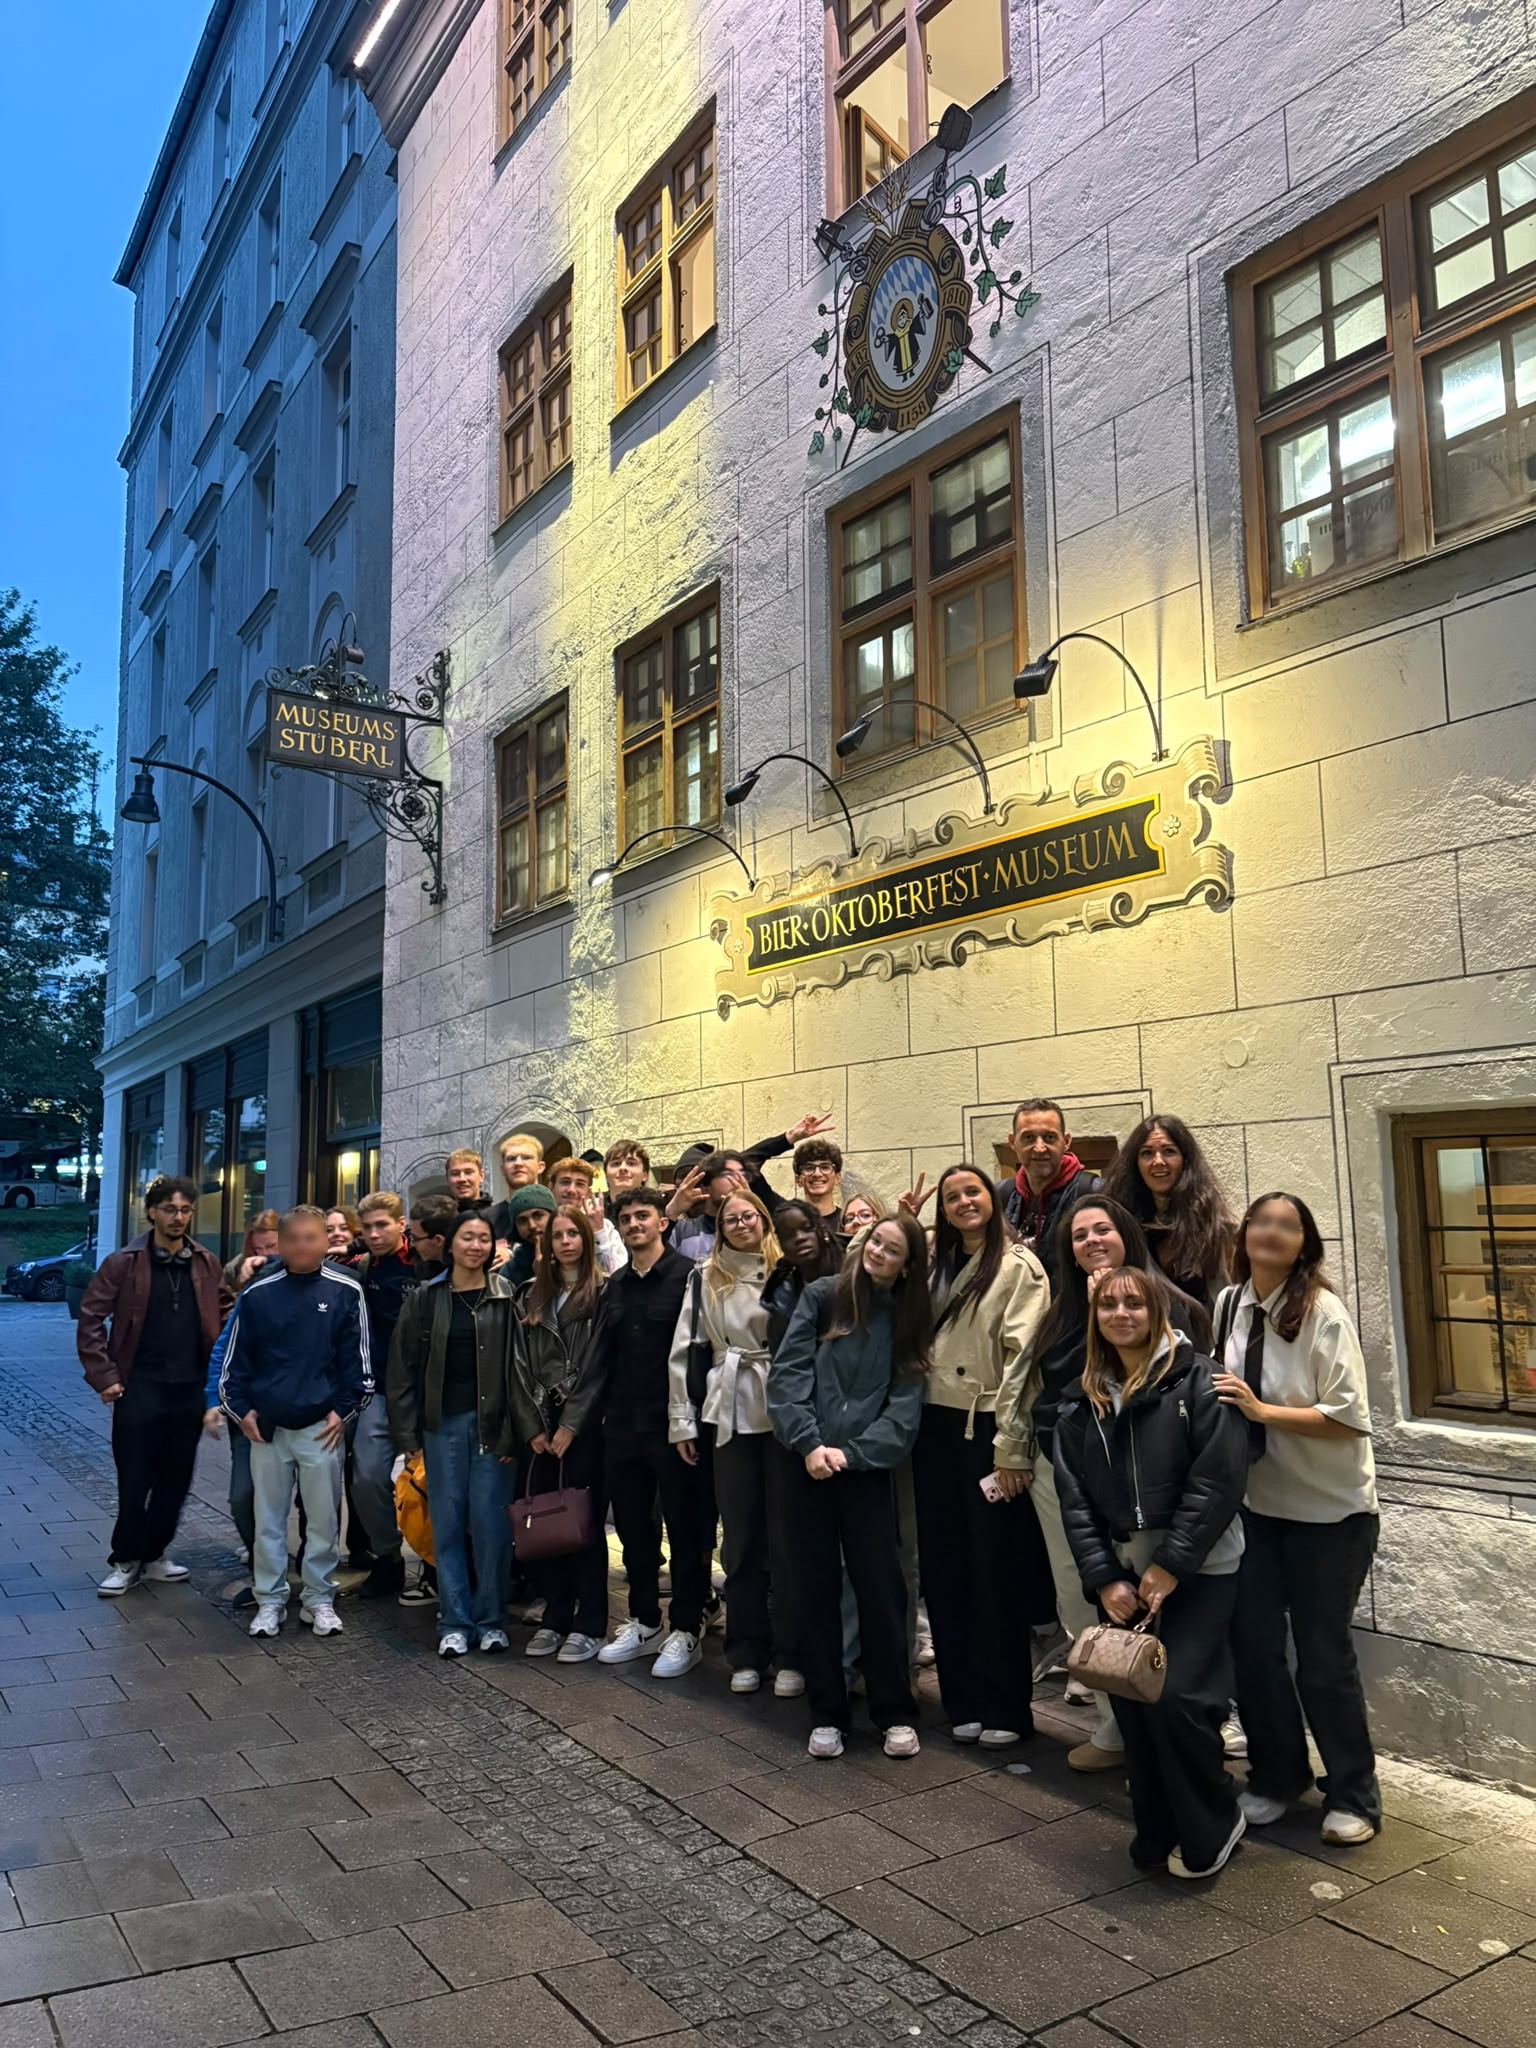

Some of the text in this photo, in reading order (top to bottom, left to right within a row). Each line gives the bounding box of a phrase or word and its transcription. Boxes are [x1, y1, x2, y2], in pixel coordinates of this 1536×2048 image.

[942, 287, 967, 306] 1810
[900, 400, 927, 427] 1158
[279, 728, 394, 769] STÜBERL
[991, 821, 1139, 894] MUSEUM
